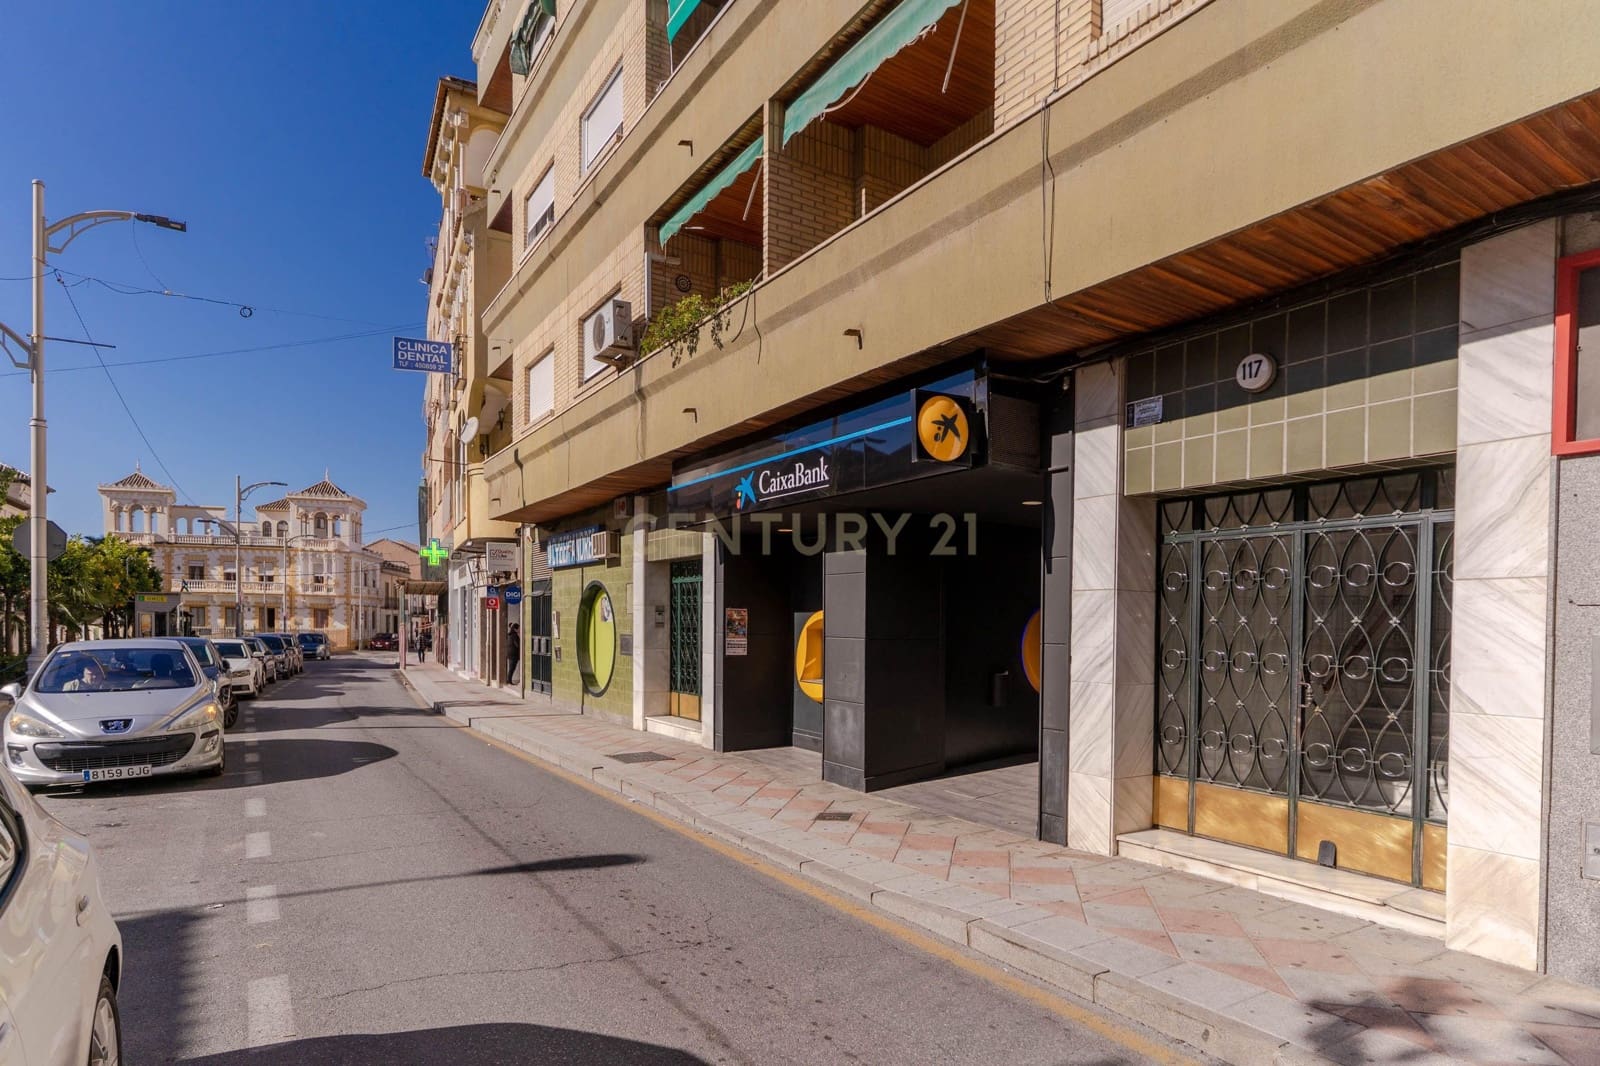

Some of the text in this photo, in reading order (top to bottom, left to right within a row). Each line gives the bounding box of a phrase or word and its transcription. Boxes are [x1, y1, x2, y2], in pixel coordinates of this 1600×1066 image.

[398, 341, 447, 355] CLINICA
[398, 350, 448, 365] DENTAL
[1242, 359, 1263, 381] 117
[758, 456, 830, 495] CaixaBank
[91, 766, 150, 780] 8159 GJG
